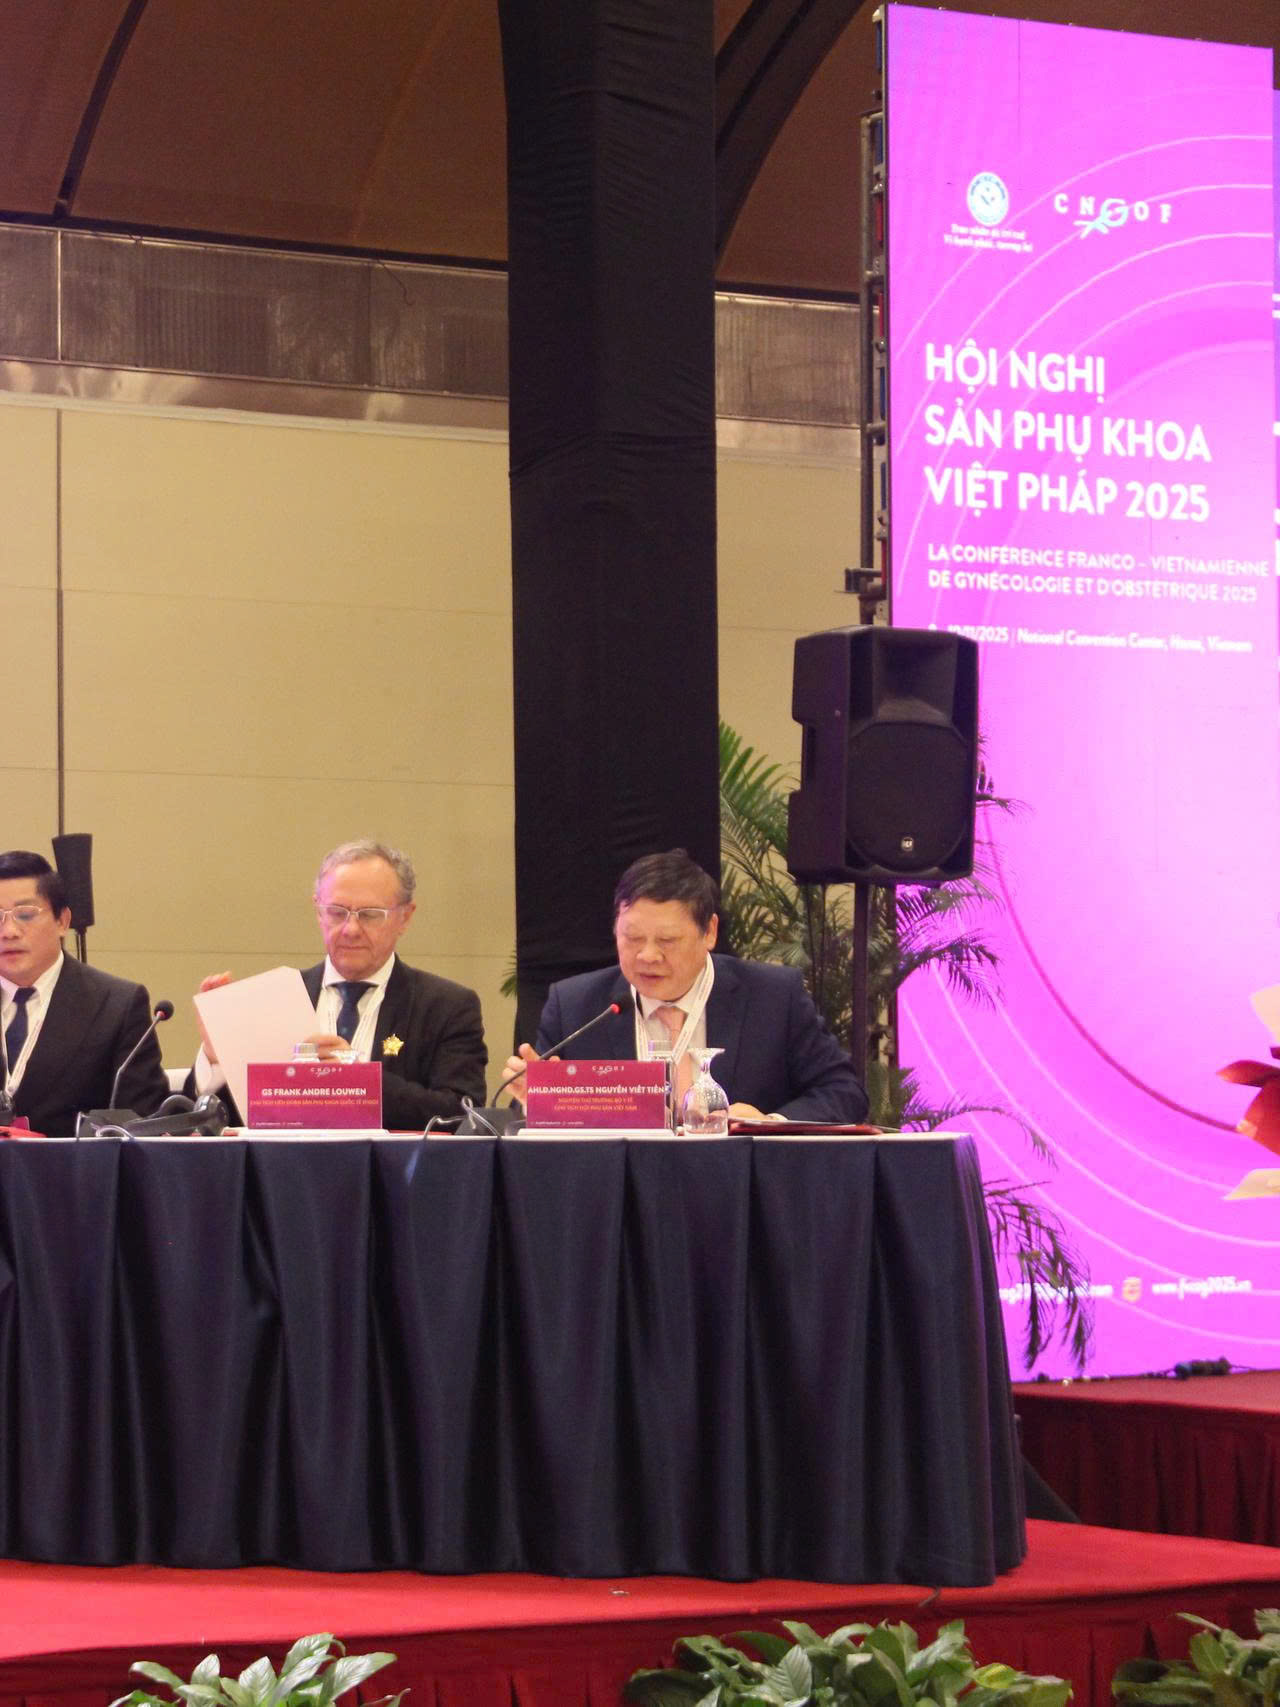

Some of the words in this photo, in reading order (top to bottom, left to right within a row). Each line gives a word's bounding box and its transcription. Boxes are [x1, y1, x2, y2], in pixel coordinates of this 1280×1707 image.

[925, 337, 998, 394] HỘI
[1009, 350, 1105, 403] NGHỊ
[924, 397, 1002, 450] SẢN
[1013, 409, 1091, 463] PHỤ
[1103, 416, 1212, 463] KHOA
[923, 460, 1008, 518] VIỆT
[1017, 468, 1119, 516] PHÁP
[1124, 481, 1210, 523] 2025
[927, 543, 949, 562] LA
[1067, 550, 1136, 572] FRANCO
[1150, 554, 1270, 578] VIETNAMIENNE
[927, 569, 951, 590] DE
[1074, 577, 1094, 597] ET
[1221, 584, 1258, 603] 2025
[261, 1088, 273, 1097] GS
[274, 1087, 301, 1097] FRANK
[331, 1087, 367, 1096] LOUWEN
